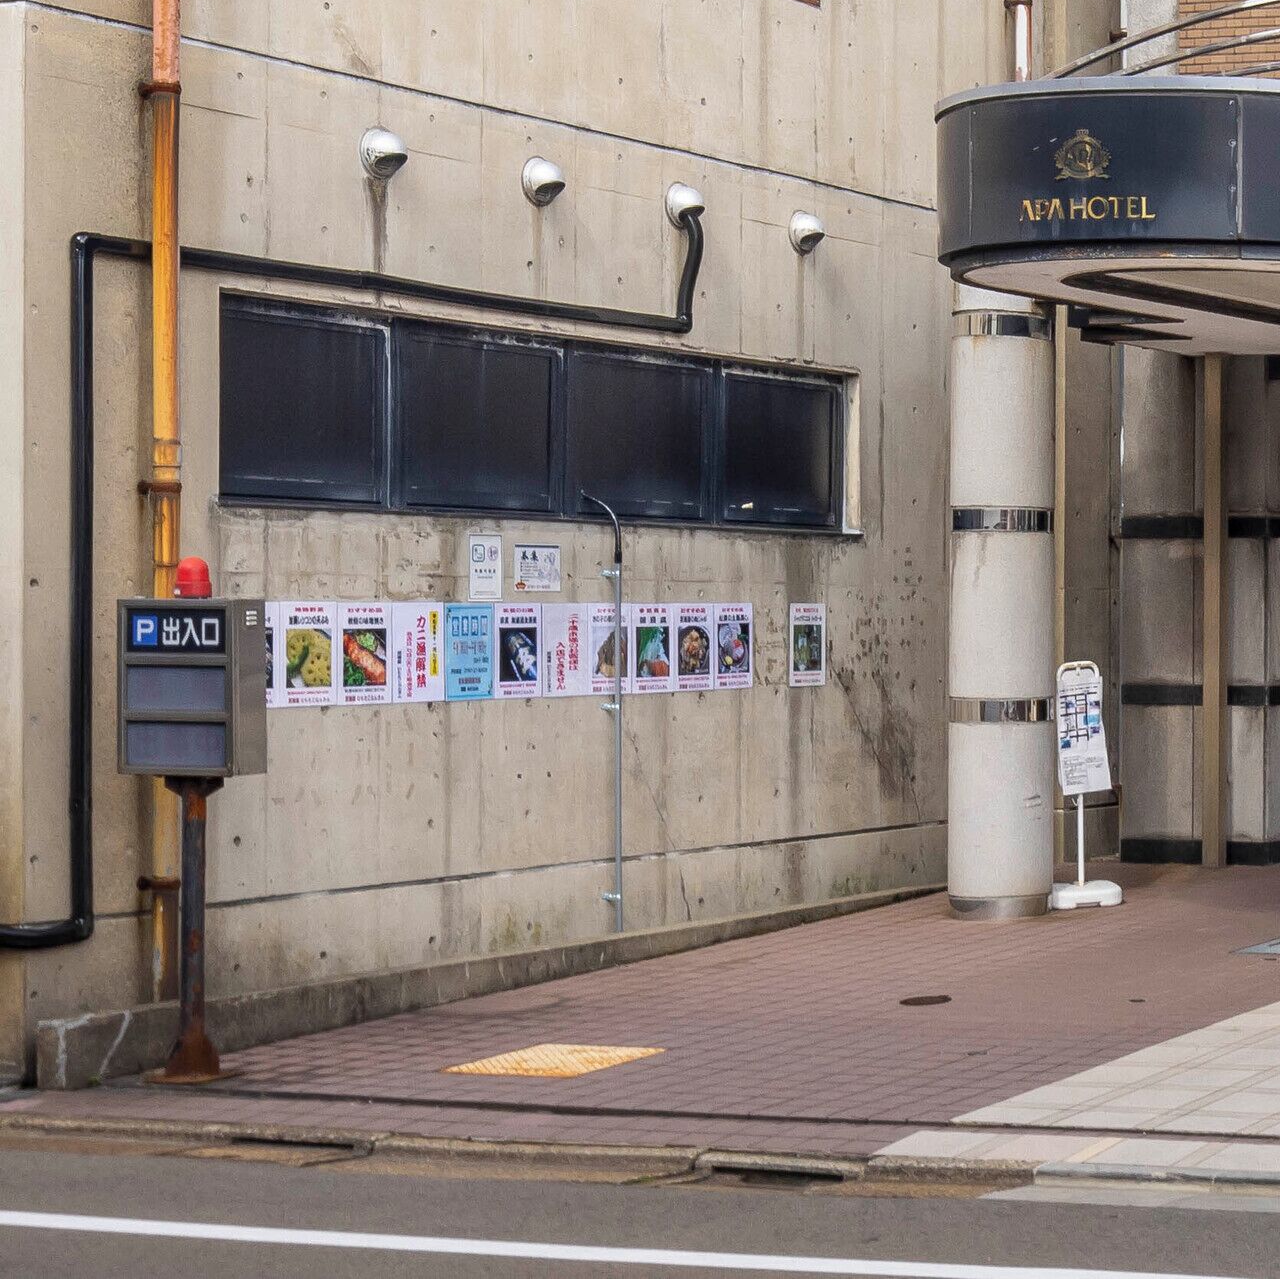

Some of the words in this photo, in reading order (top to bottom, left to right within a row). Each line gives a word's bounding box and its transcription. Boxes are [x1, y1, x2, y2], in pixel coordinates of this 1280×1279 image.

[1020, 198, 1065, 221] APA
[1069, 196, 1156, 220] HOTEL
[136, 618, 155, 643] P
[162, 617, 219, 646] 出入口
